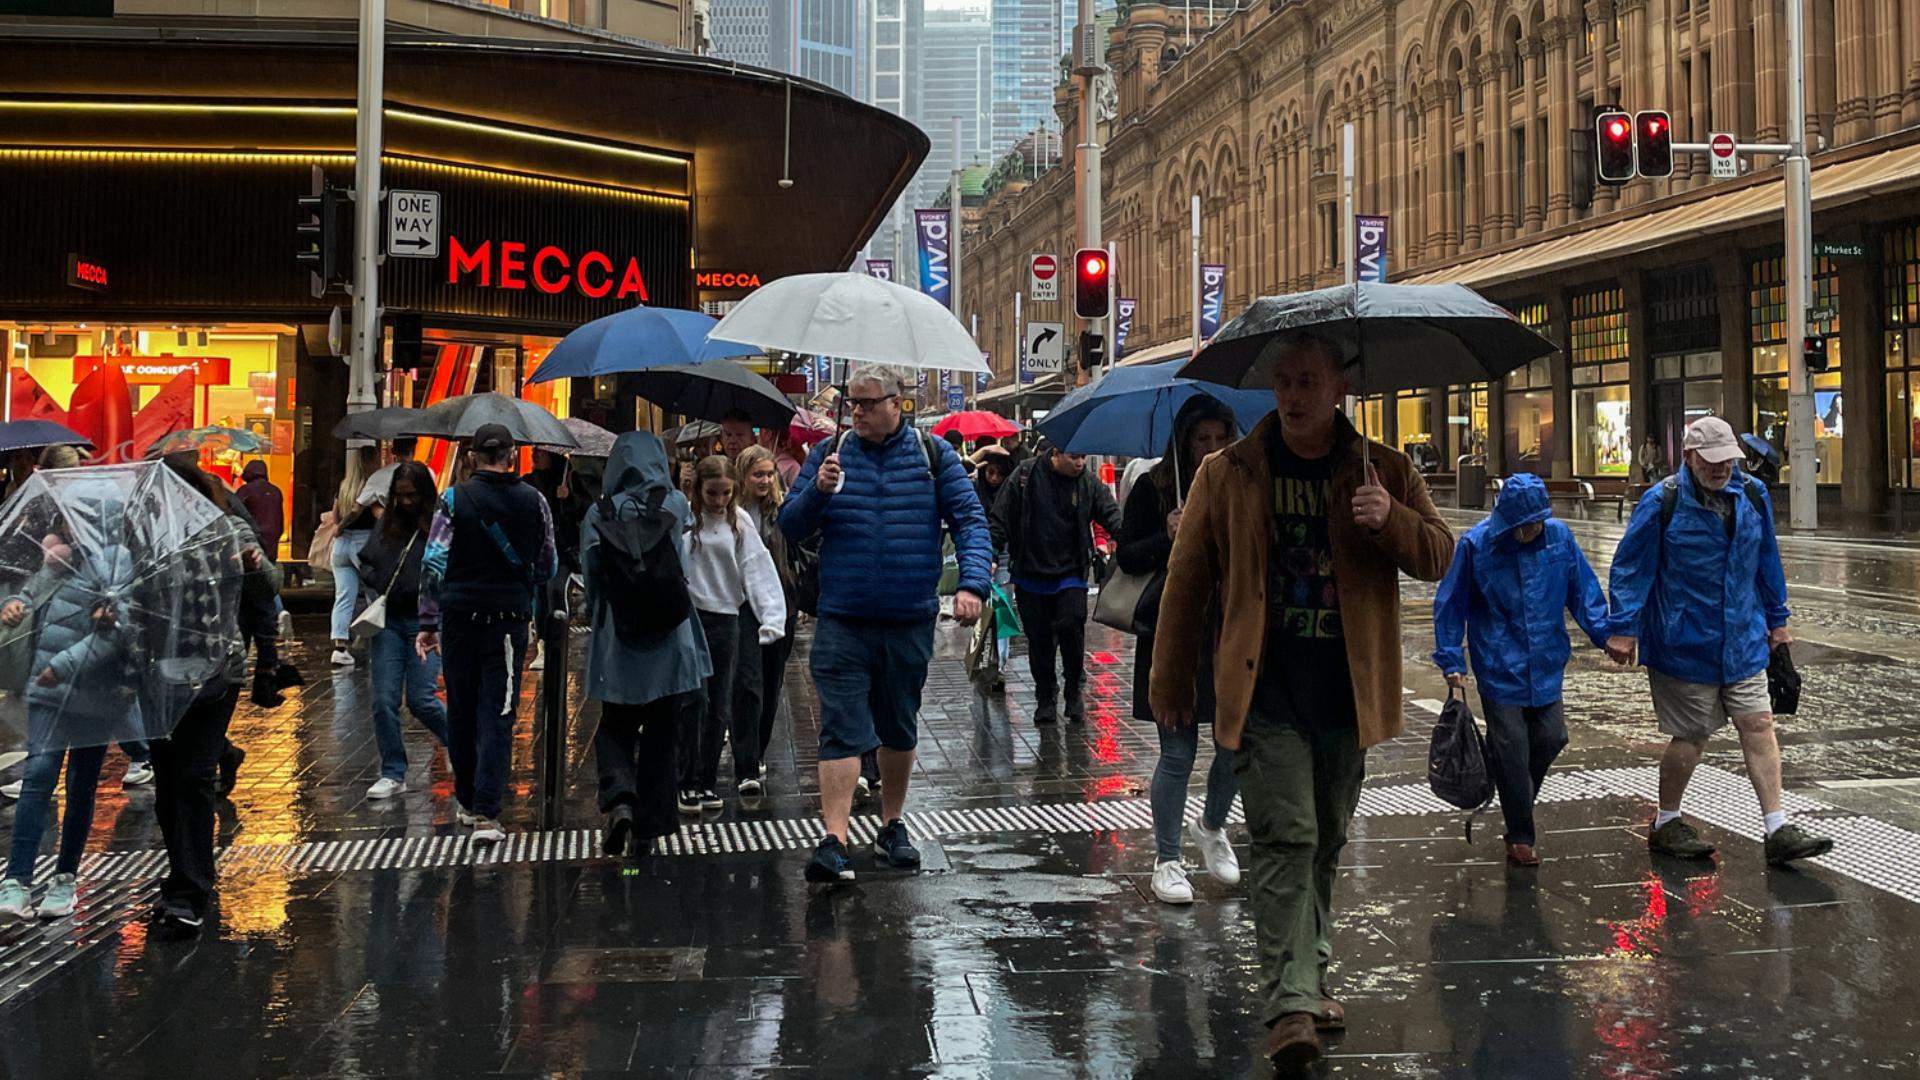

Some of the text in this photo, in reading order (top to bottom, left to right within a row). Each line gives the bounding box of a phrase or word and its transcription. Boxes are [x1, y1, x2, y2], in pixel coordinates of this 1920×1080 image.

[398, 198, 431, 213] ONE
[395, 217, 433, 233] WAY
[1824, 246, 1862, 255] Market St
[77, 260, 107, 286] MECCA
[449, 235, 649, 301] MECCA
[696, 273, 761, 287] MECCA
[1028, 358, 1060, 368] ONLY
